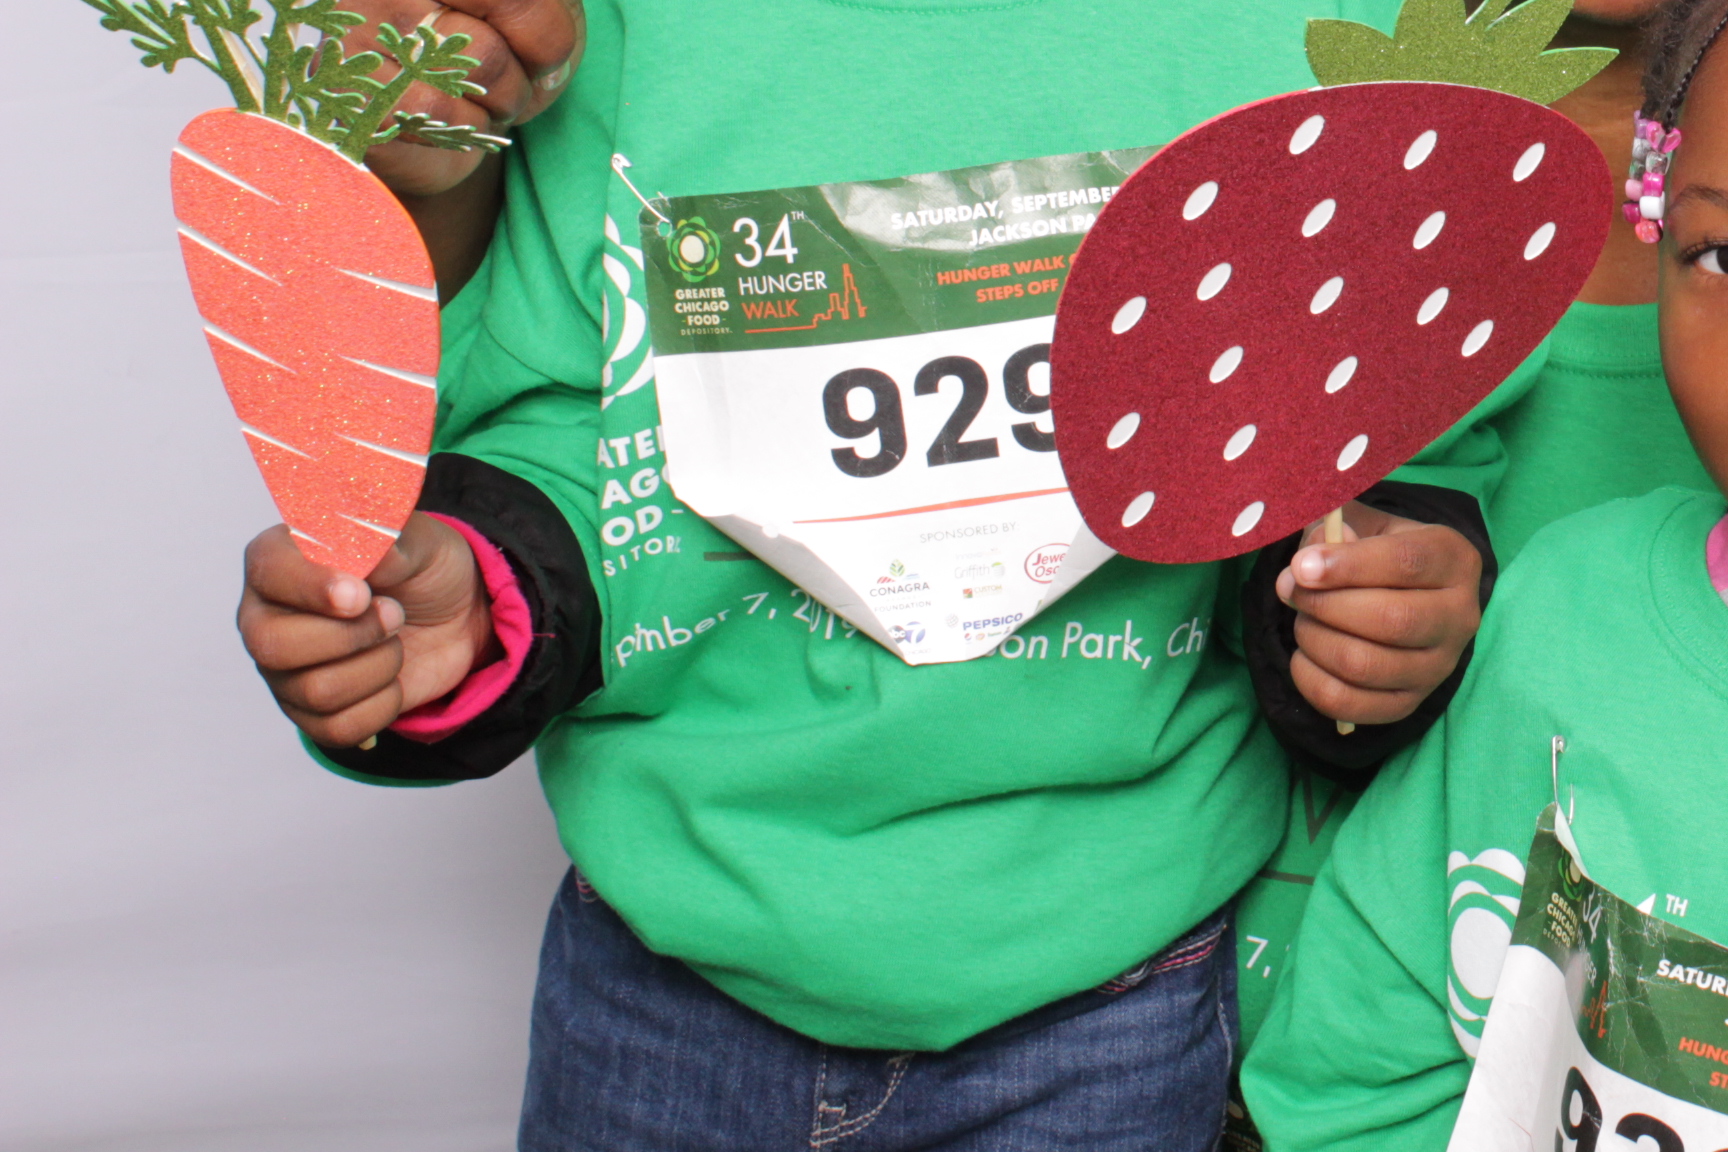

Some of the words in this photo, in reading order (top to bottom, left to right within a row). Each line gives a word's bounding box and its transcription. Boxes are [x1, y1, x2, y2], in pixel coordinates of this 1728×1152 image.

[890, 200, 1004, 230] SATURDAY,
[969, 216, 1067, 247] JACKSON
[937, 263, 1011, 286] HUNGER
[1013, 254, 1066, 275] WALK
[675, 287, 726, 300] GREATER
[738, 271, 827, 296] HUNGER
[976, 283, 1024, 303] STEPS
[1027, 278, 1059, 297] OFF
[674, 300, 729, 313] CHICAGO
[741, 299, 800, 319] WALK
[919, 523, 999, 544] SPONSORED
[870, 581, 930, 597] CONAGRA
[874, 601, 932, 613] FOUNDATION
[963, 612, 1023, 631] PEPSICO
[1061, 620, 1152, 670] Park,
